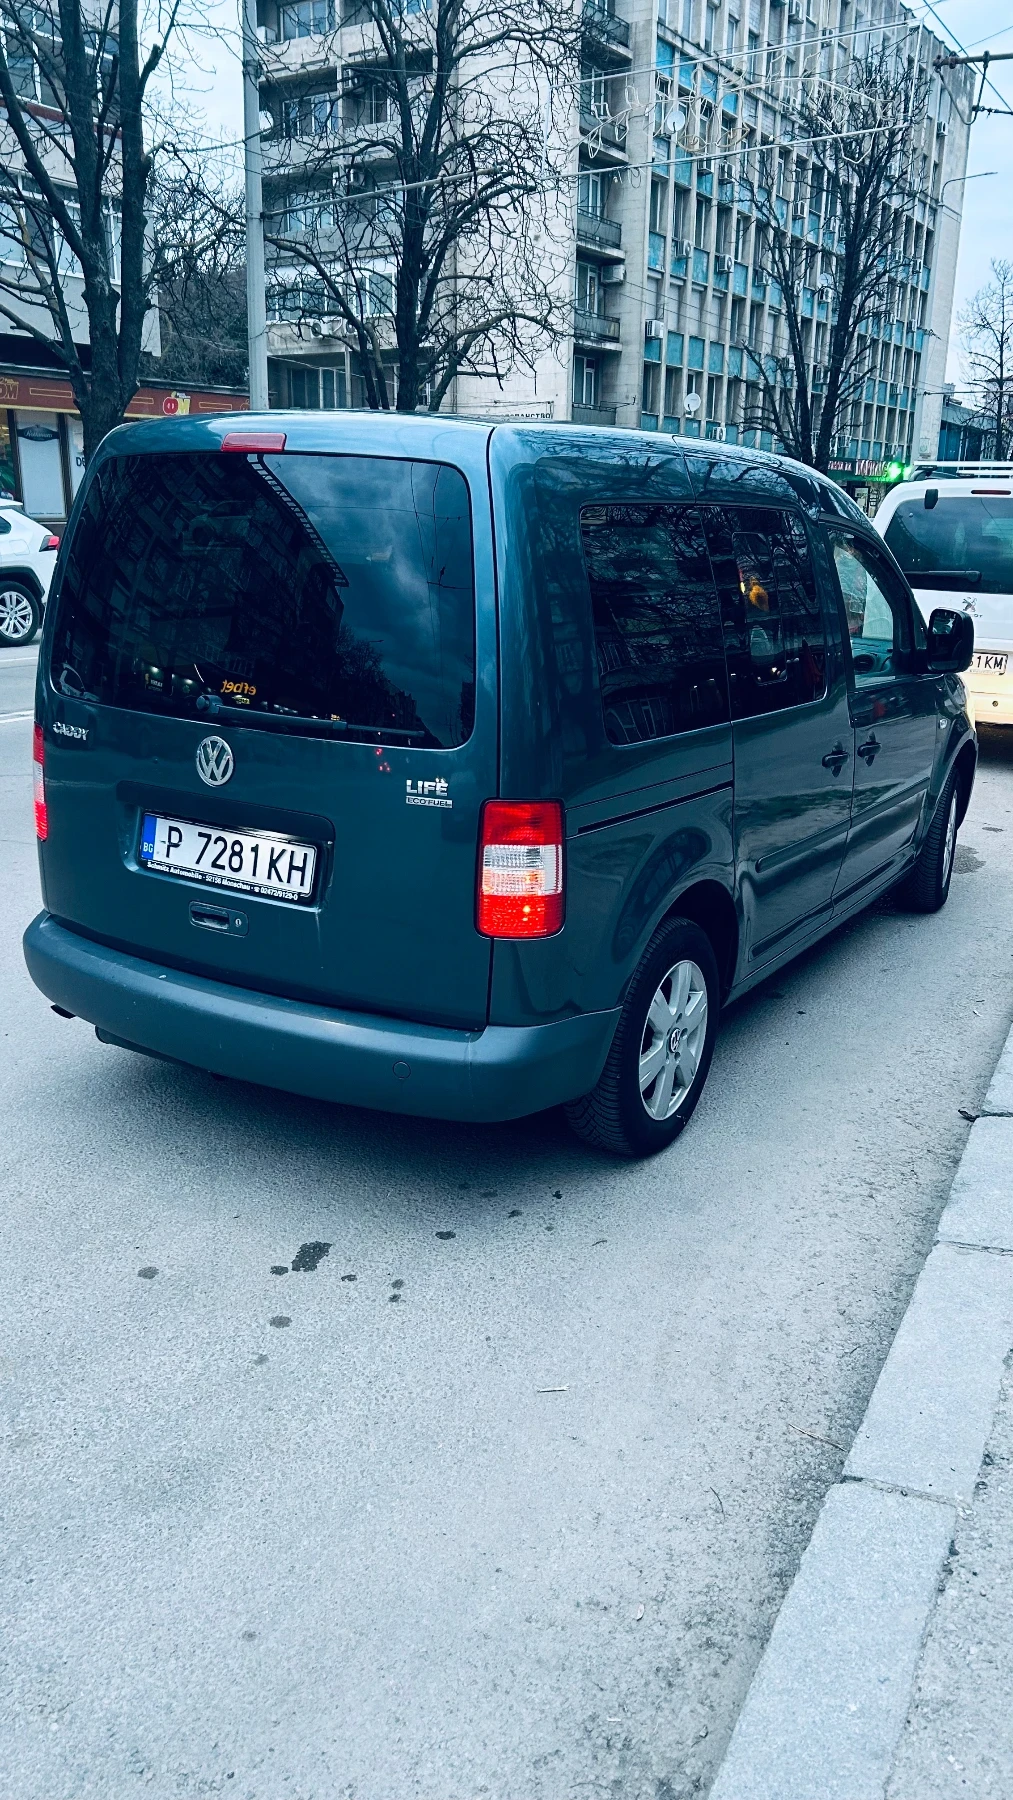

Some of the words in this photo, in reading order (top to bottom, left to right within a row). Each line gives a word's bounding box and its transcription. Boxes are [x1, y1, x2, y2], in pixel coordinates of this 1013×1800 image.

[53, 721, 89, 741] CADDY
[406, 779, 449, 797] LIFE
[143, 841, 154, 853] BG
[165, 825, 183, 859] P
[147, 861, 170, 873] Schmitz
[170, 867, 202, 880] Automobile
[221, 877, 251, 892] Monschau
